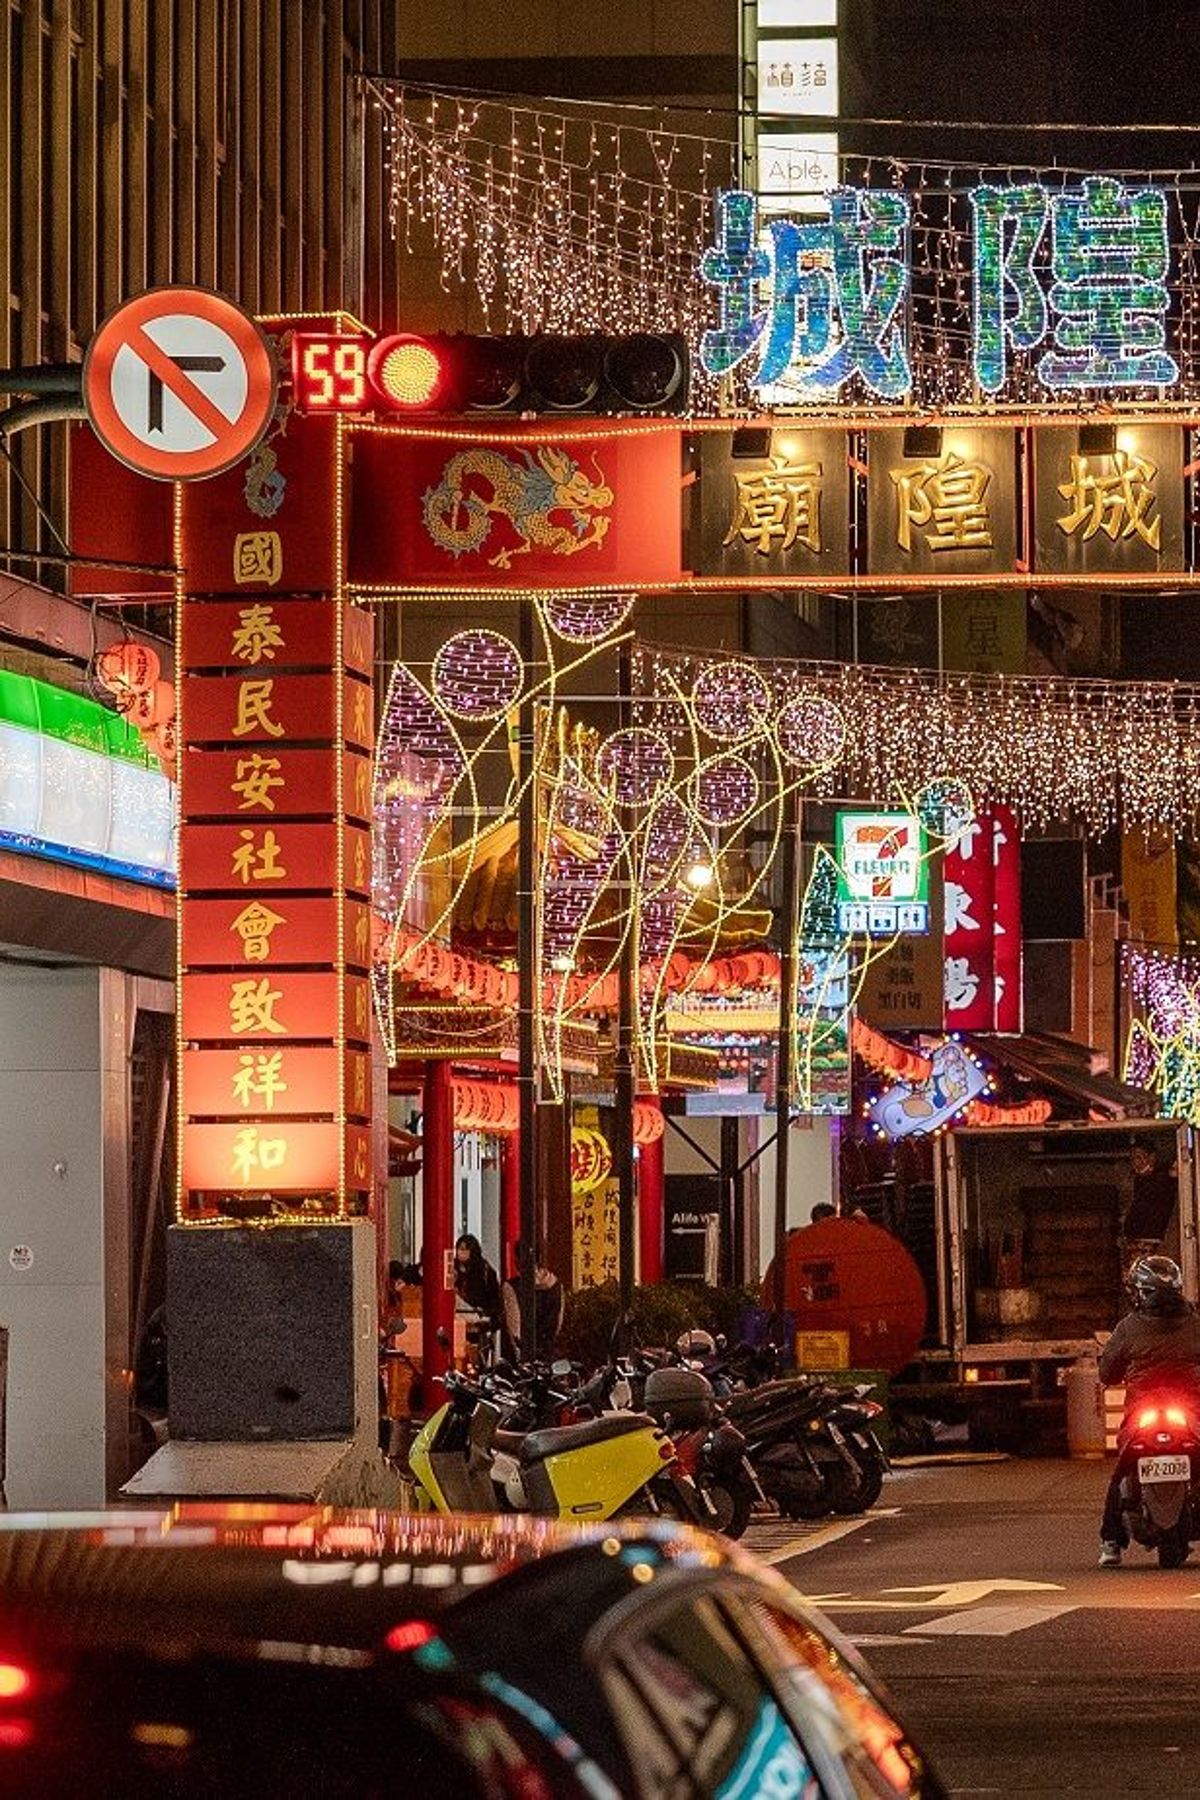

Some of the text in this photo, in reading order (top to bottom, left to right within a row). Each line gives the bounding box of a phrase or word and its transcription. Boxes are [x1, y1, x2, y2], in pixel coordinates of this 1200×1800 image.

[304, 344, 364, 404] 59
[231, 530, 288, 1184] 國泰民安社會致祥和
